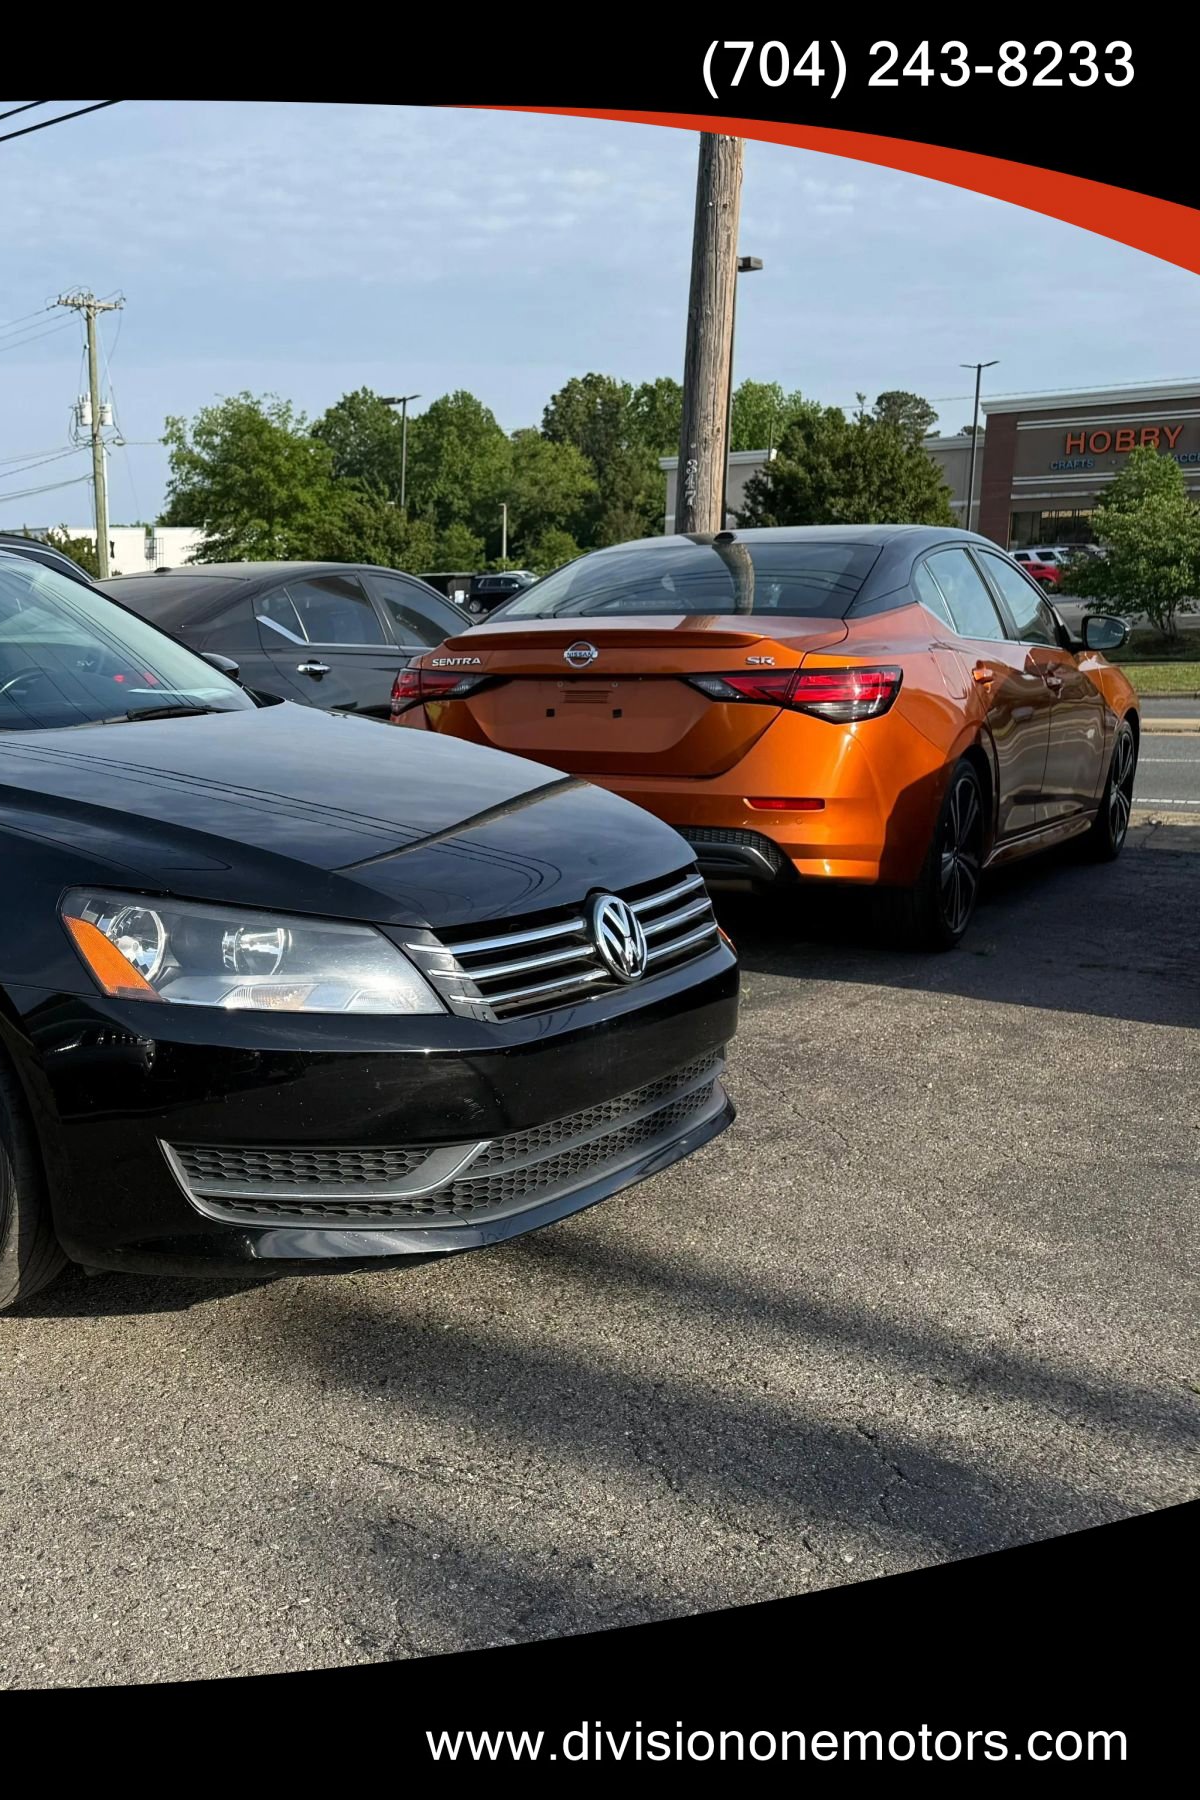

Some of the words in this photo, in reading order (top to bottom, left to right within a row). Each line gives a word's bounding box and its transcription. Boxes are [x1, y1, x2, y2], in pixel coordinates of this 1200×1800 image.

[1065, 423, 1185, 455] HOBBY
[1050, 458, 1095, 471] CRAFTS
[566, 650, 595, 659] NISSAN
[432, 657, 482, 667] SENTRA
[745, 656, 775, 666] SR
